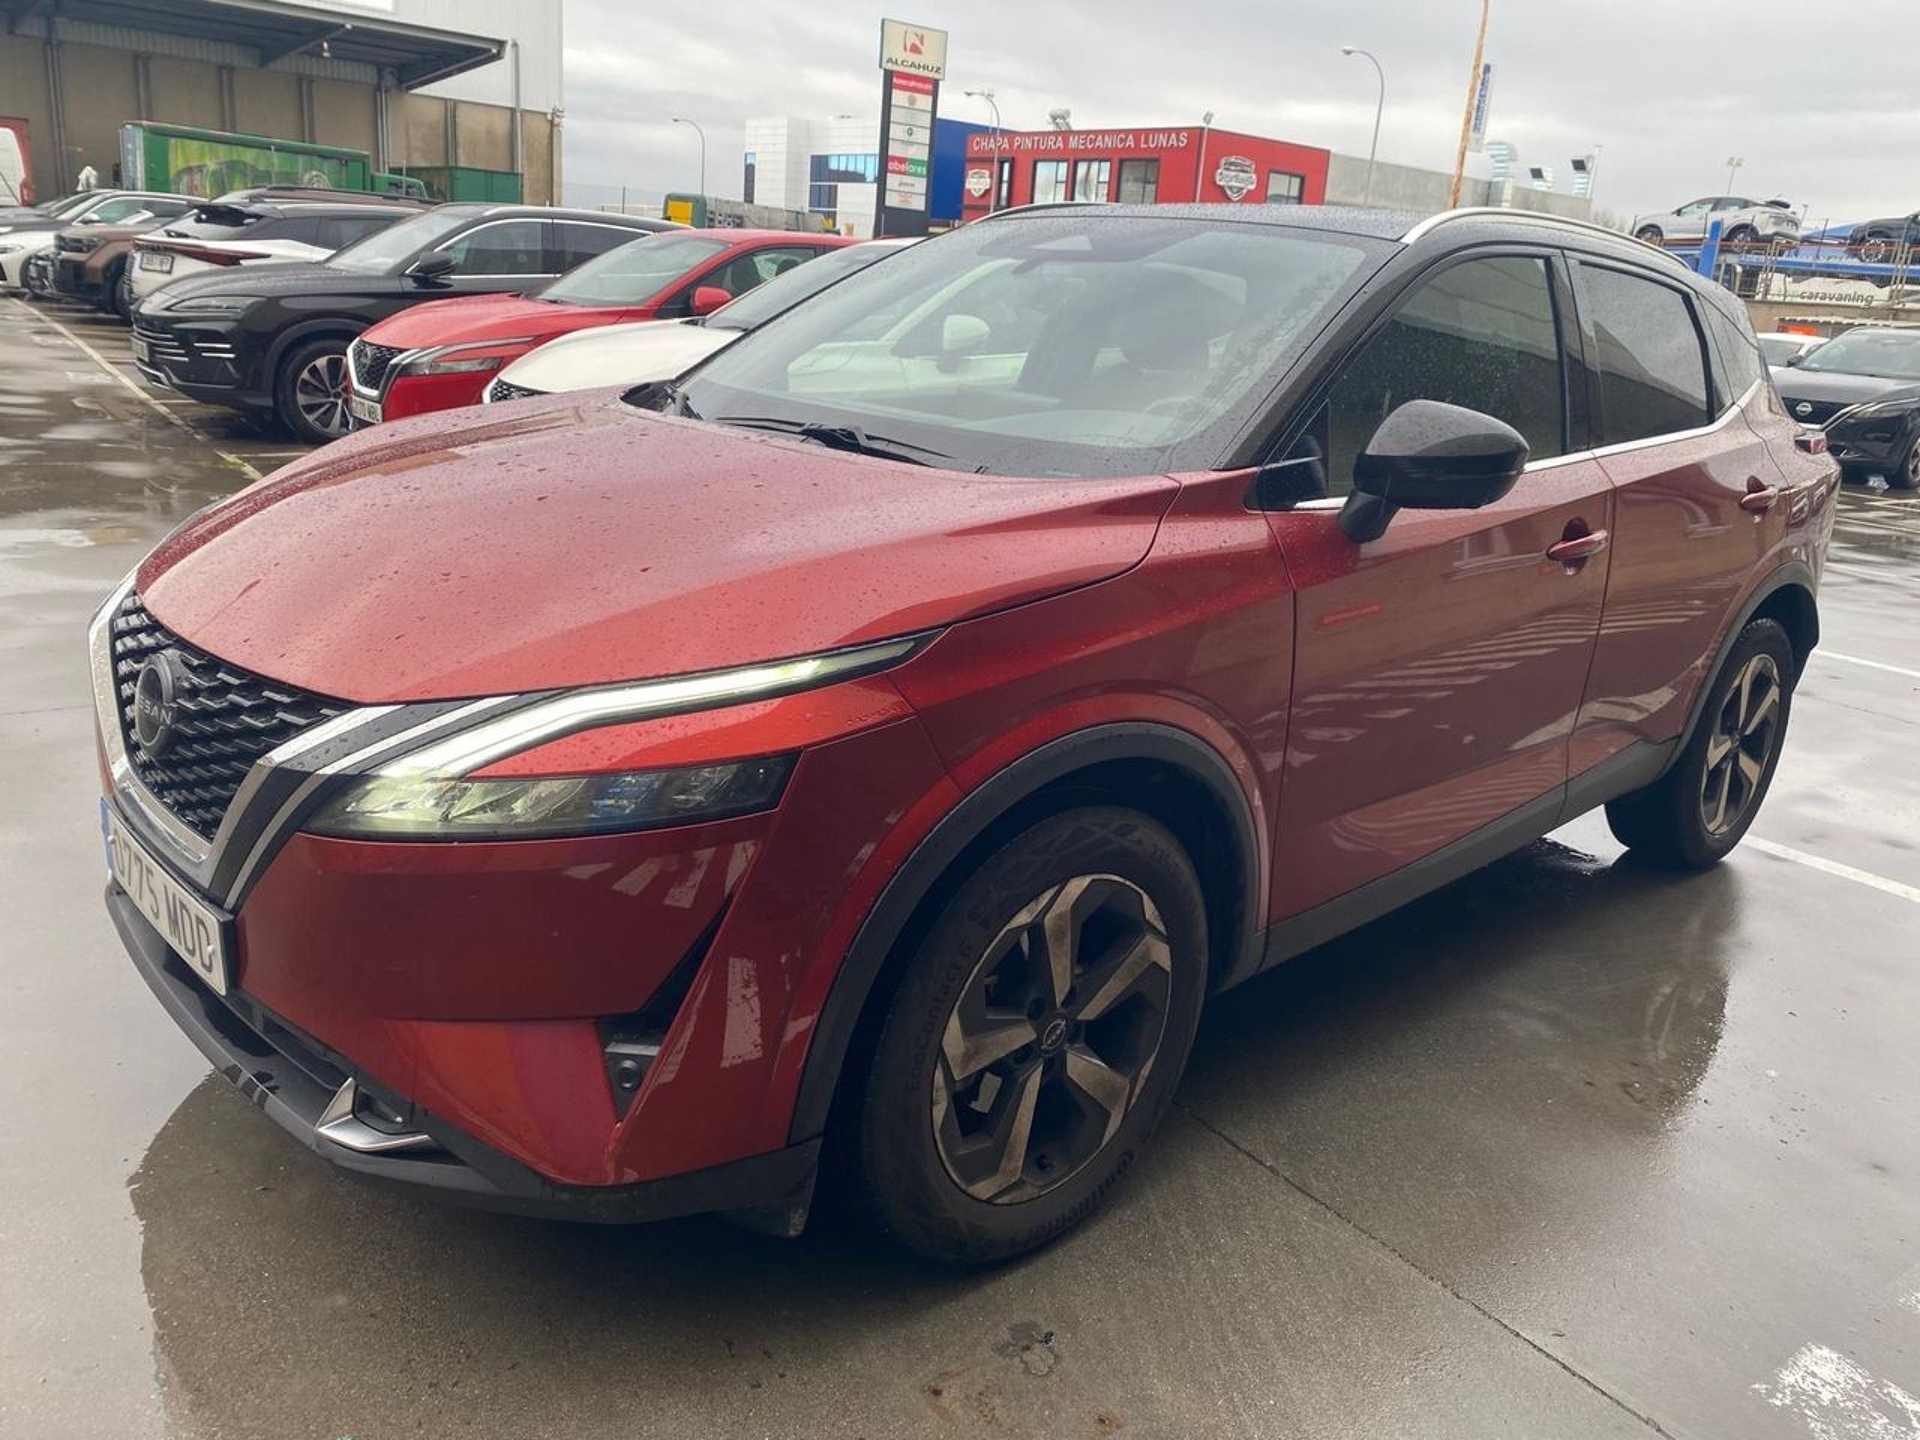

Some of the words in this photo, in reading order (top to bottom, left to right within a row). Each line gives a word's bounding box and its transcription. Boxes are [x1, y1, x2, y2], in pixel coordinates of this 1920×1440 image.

[886, 57, 942, 74] ALCAHUZ
[973, 137, 1009, 151] CHAPA
[1013, 135, 1063, 150] PINTURA
[1068, 134, 1135, 149] MECANICA
[1140, 132, 1188, 148] LUNAS
[1800, 290, 1874, 308] caravaning
